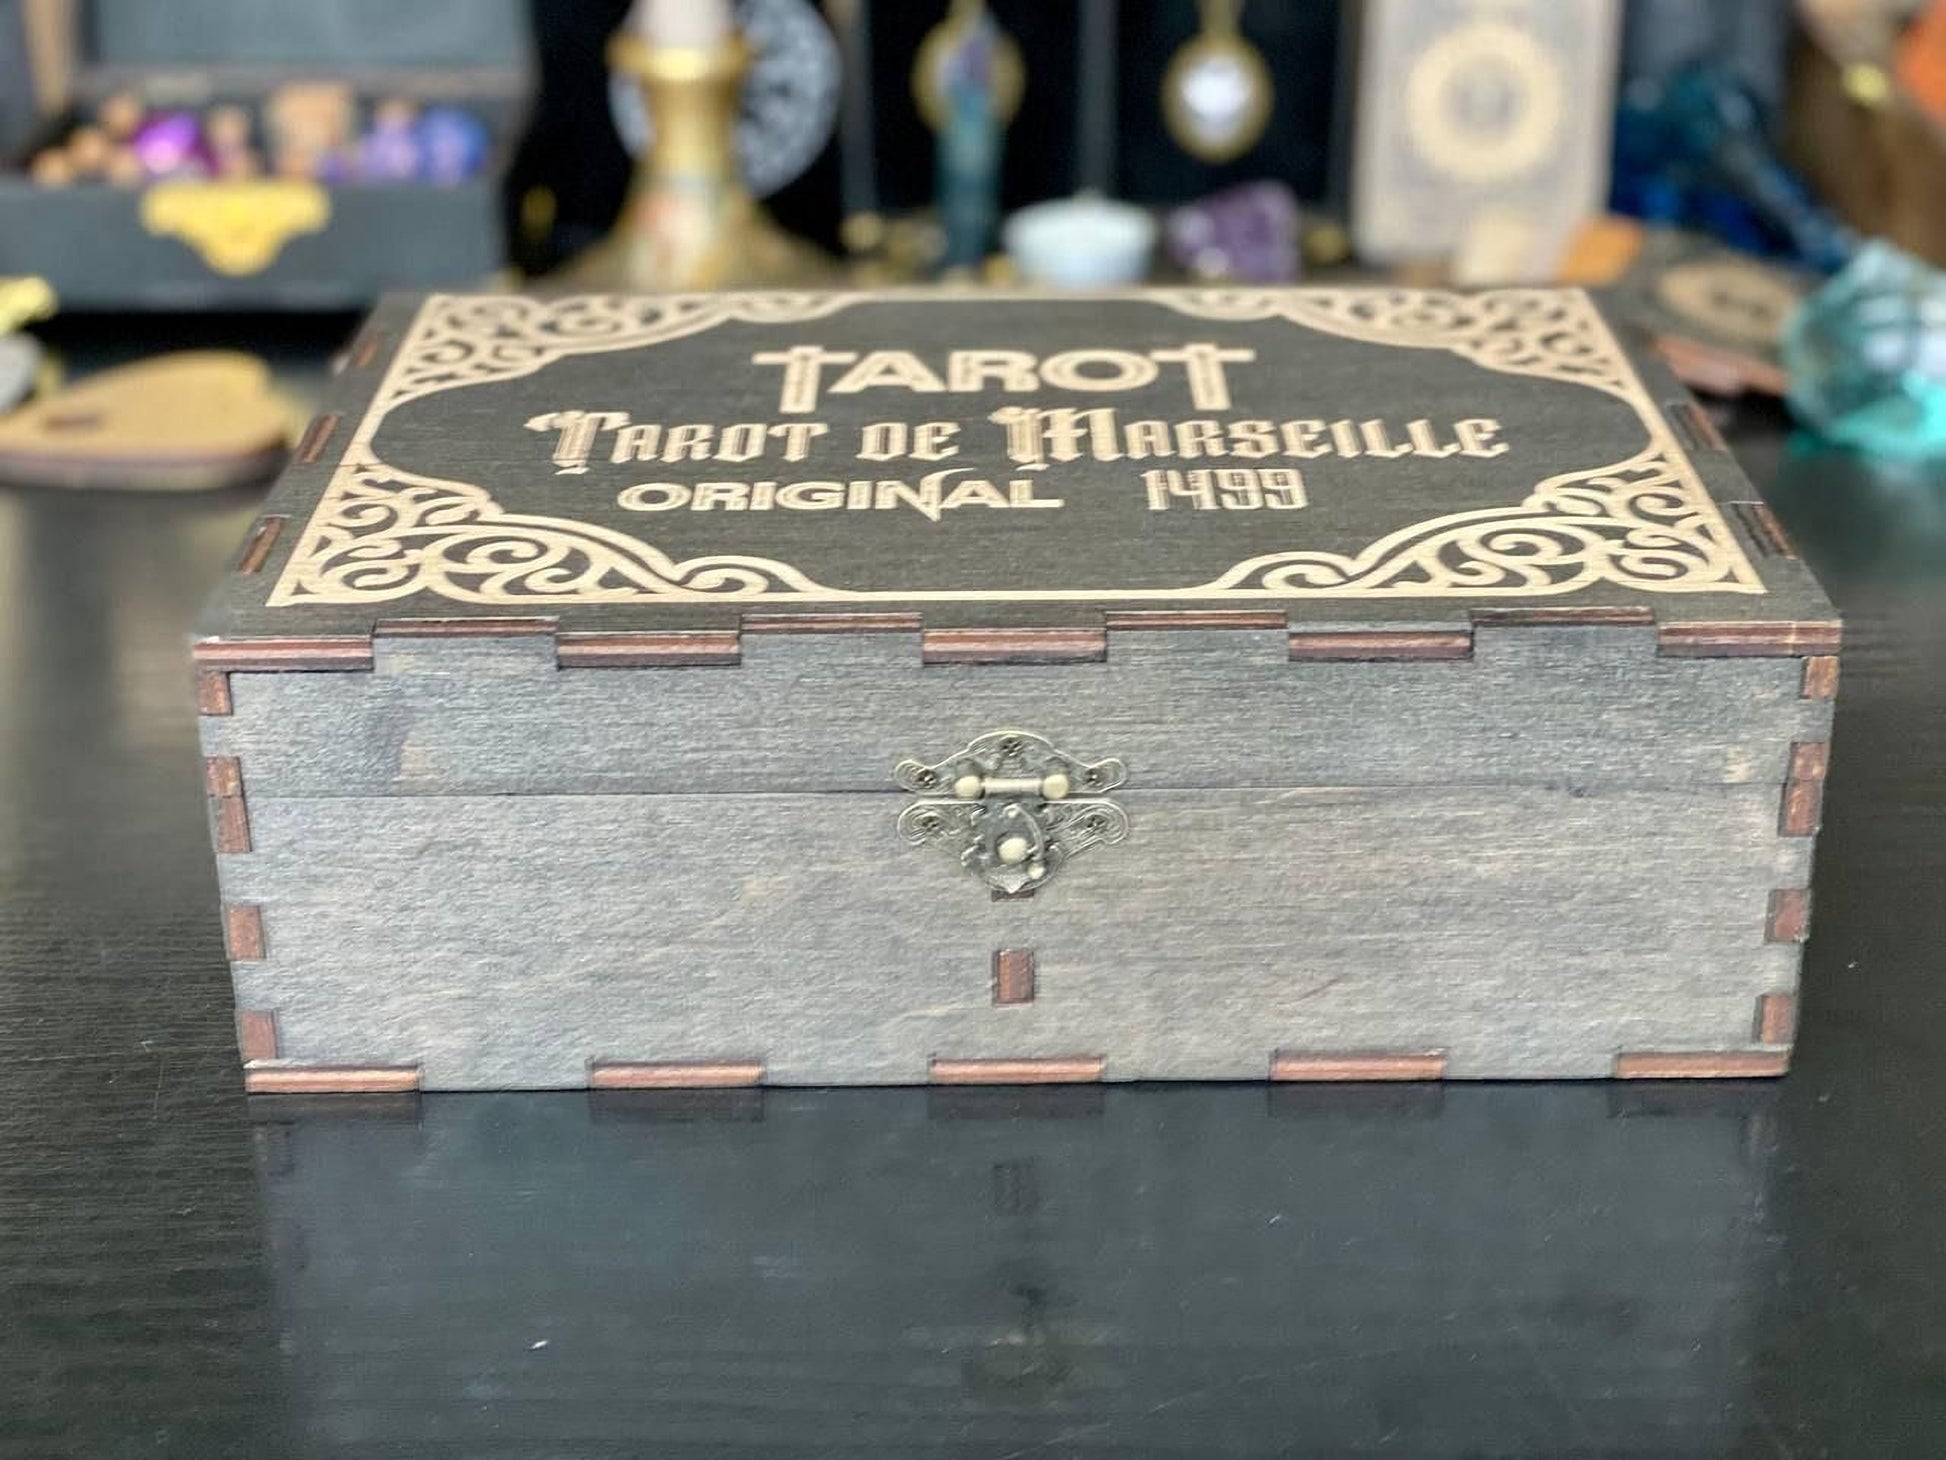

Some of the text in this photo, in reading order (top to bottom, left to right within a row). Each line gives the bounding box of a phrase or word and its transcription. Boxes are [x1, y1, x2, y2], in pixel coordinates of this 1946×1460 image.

[752, 344, 1256, 414] TAROT
[617, 467, 1309, 523] ORIGINAL 1499
